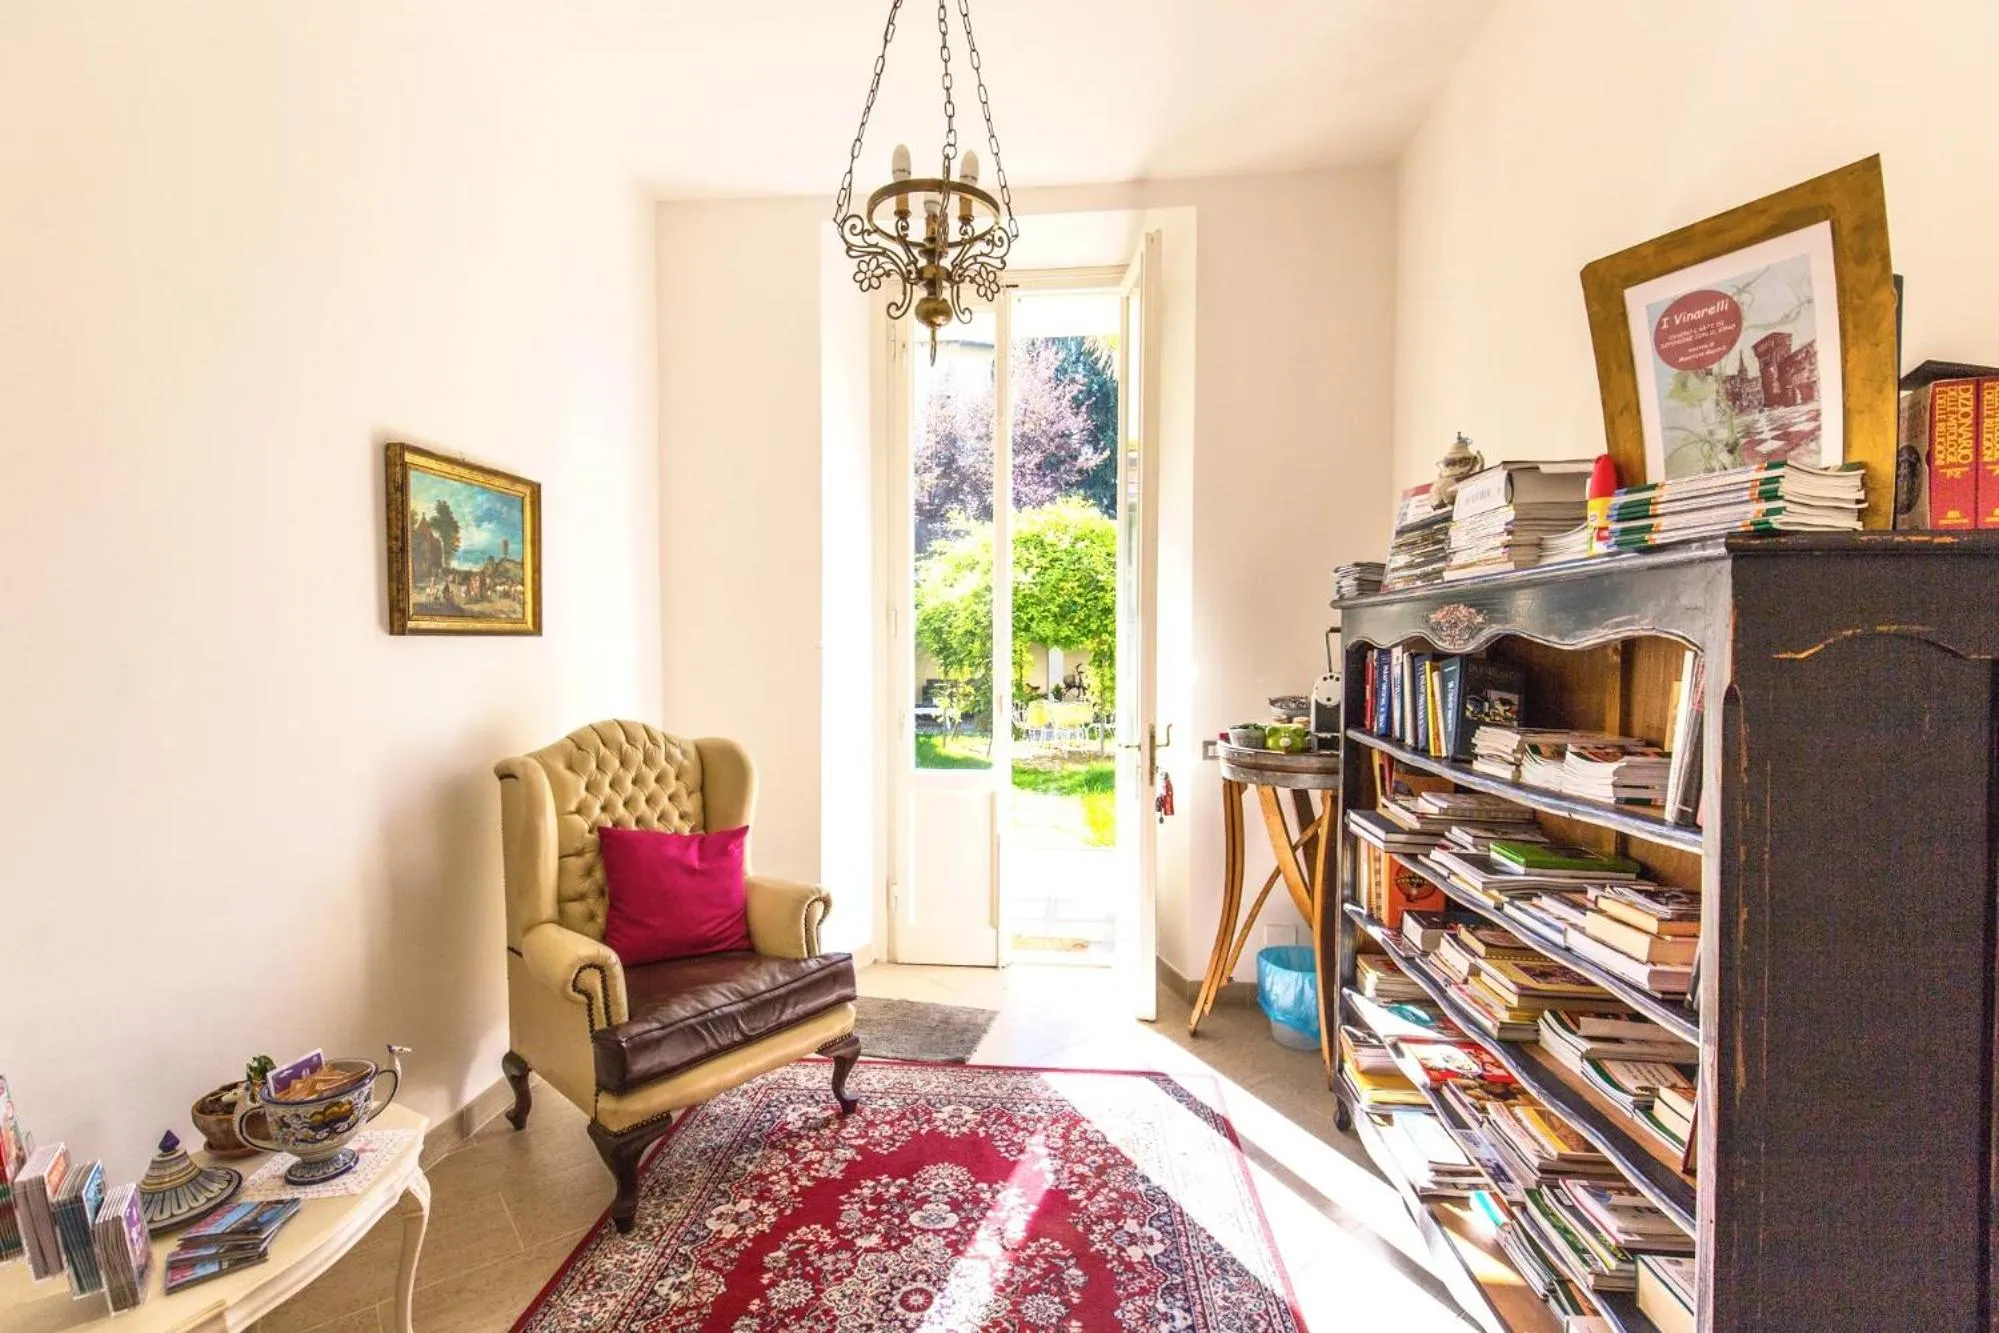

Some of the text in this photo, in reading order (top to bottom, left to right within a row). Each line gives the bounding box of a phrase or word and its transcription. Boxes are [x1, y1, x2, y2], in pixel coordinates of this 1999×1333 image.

[1661, 299, 1729, 330] I Vinarelli
[1958, 384, 1974, 464] DIZIONARIO
